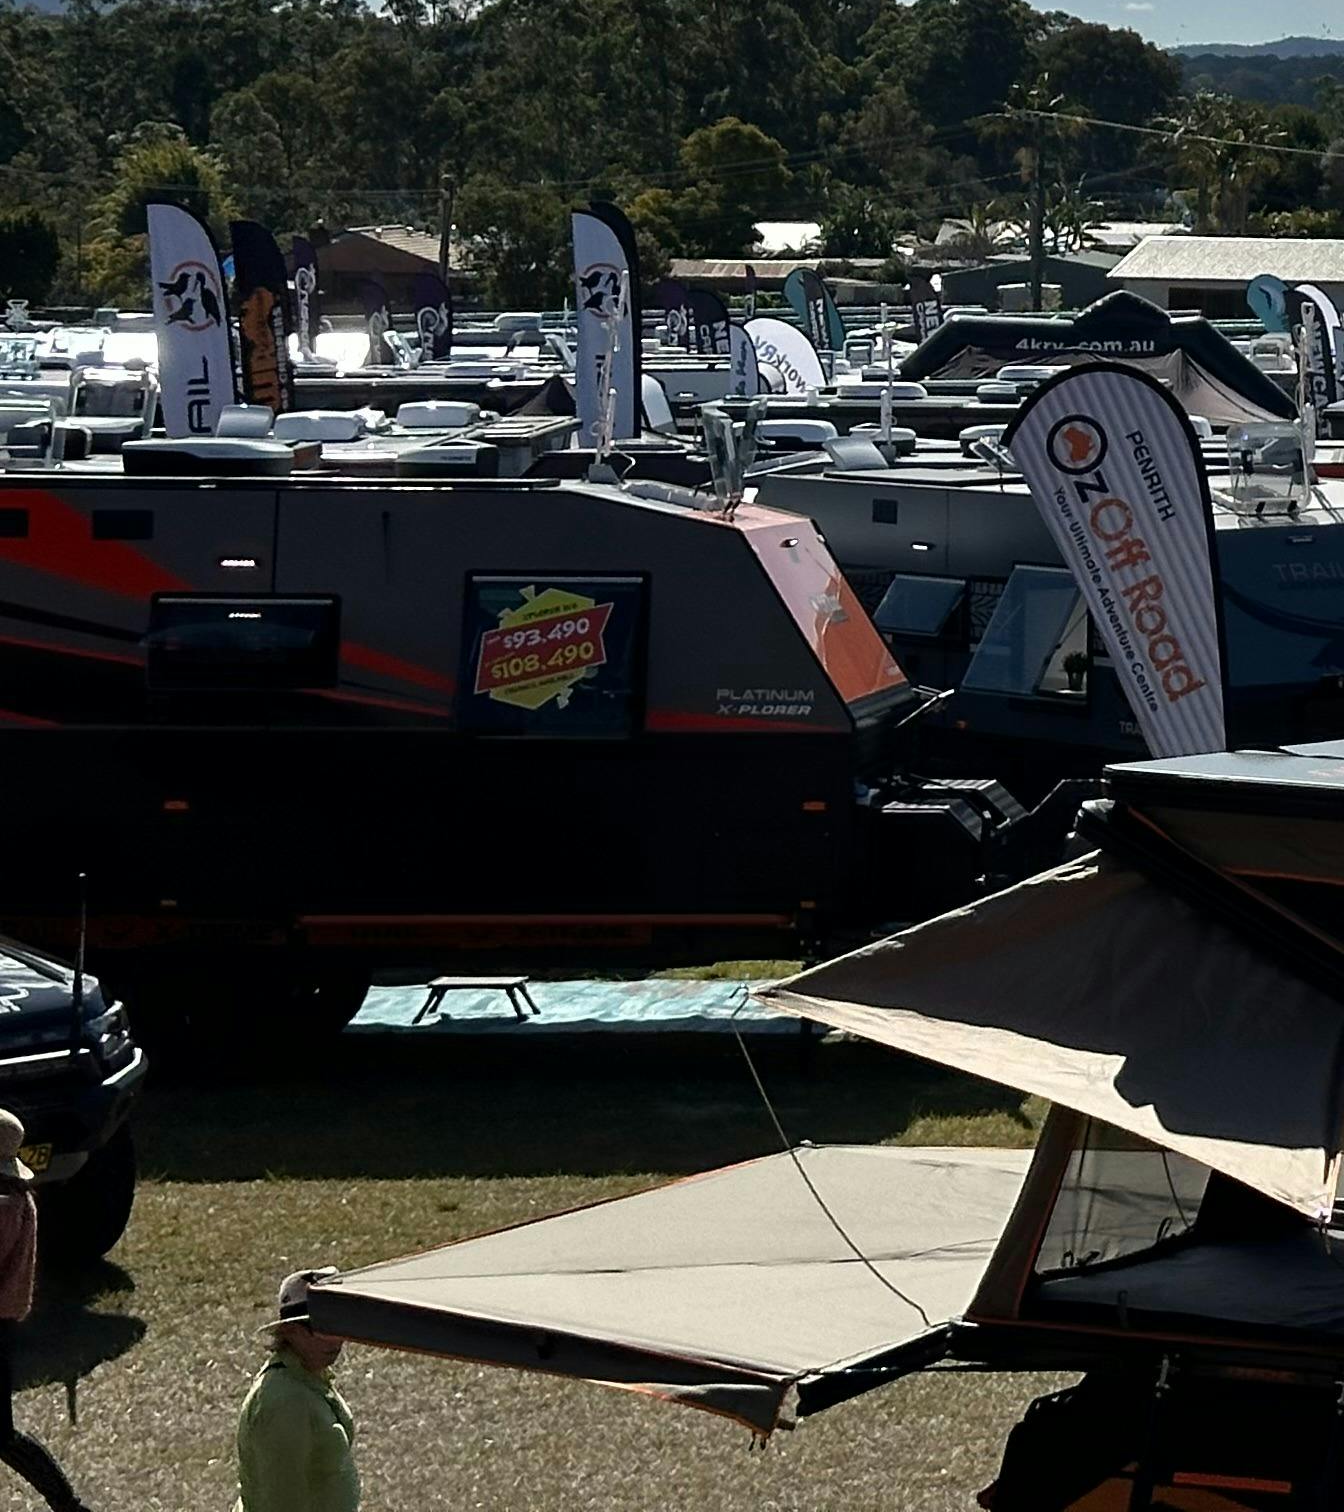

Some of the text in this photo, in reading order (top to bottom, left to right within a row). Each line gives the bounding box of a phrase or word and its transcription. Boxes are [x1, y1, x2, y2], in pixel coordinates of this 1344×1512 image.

[1125, 430, 1176, 523] PENRITH
[1053, 485, 1159, 713] Your Ultimate Adventure Centre
[716, 688, 815, 702] PLATINUM
[717, 703, 812, 716] X-PLORER
